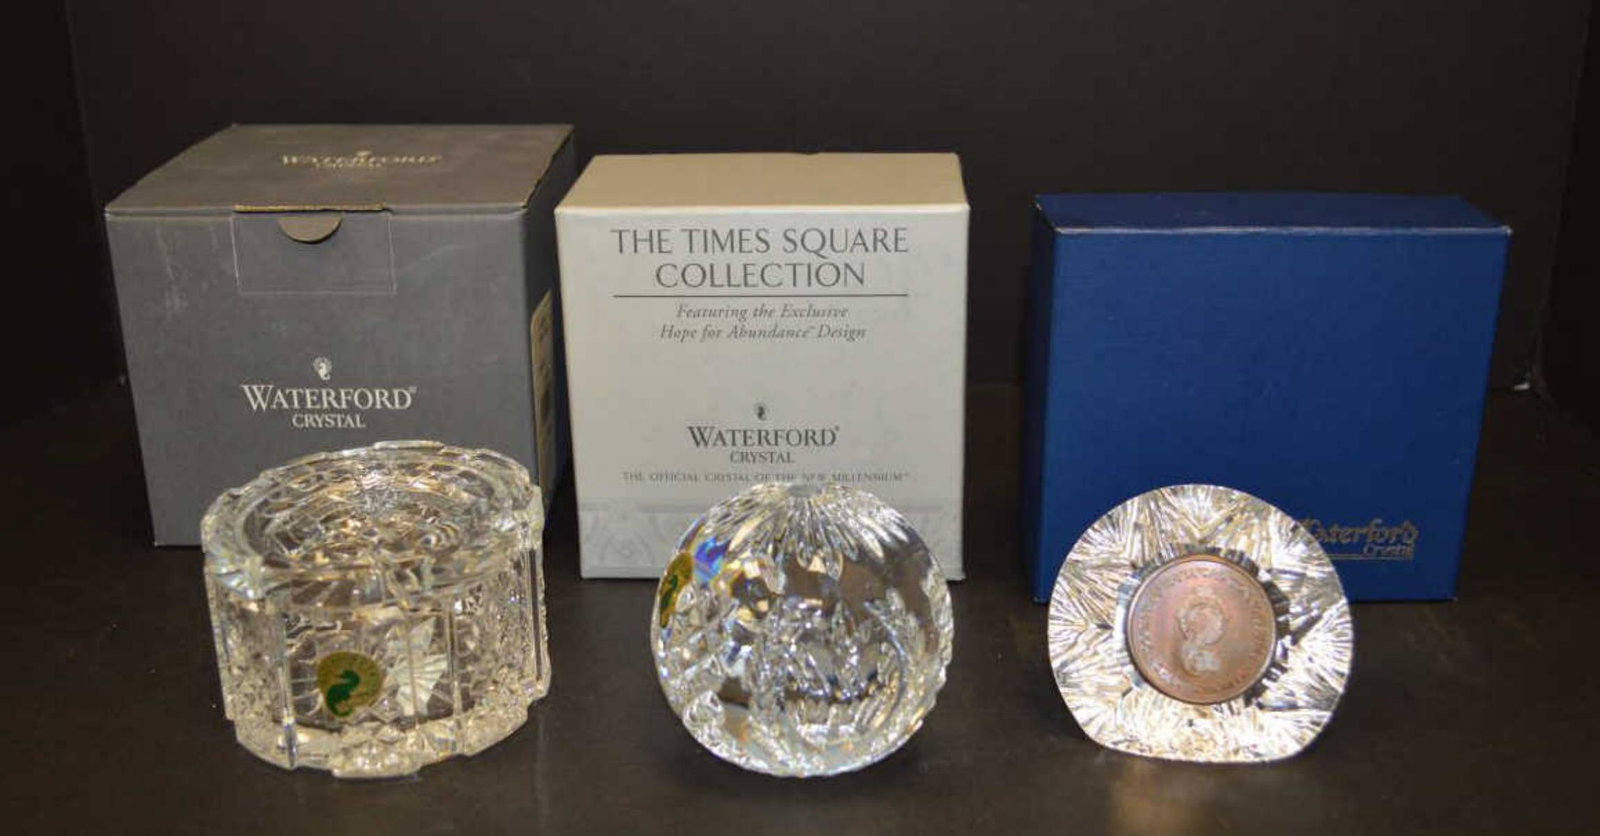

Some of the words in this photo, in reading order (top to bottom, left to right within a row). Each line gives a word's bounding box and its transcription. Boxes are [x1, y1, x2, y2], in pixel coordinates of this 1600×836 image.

[610, 228, 673, 254] THE
[680, 227, 771, 254] TIMES
[782, 227, 909, 259] SQUARE
[655, 262, 865, 289] COLLECTION
[676, 303, 748, 321] Featuring
[752, 303, 774, 319] the
[780, 304, 849, 319] Exclusive
[660, 324, 698, 342] Hope
[699, 324, 723, 342] for
[817, 324, 866, 342] Design
[291, 413, 367, 429] CRYSTAL
[729, 450, 796, 464] CRYSTAL
[623, 471, 644, 482] THE
[648, 471, 698, 483] OFFICIAL
